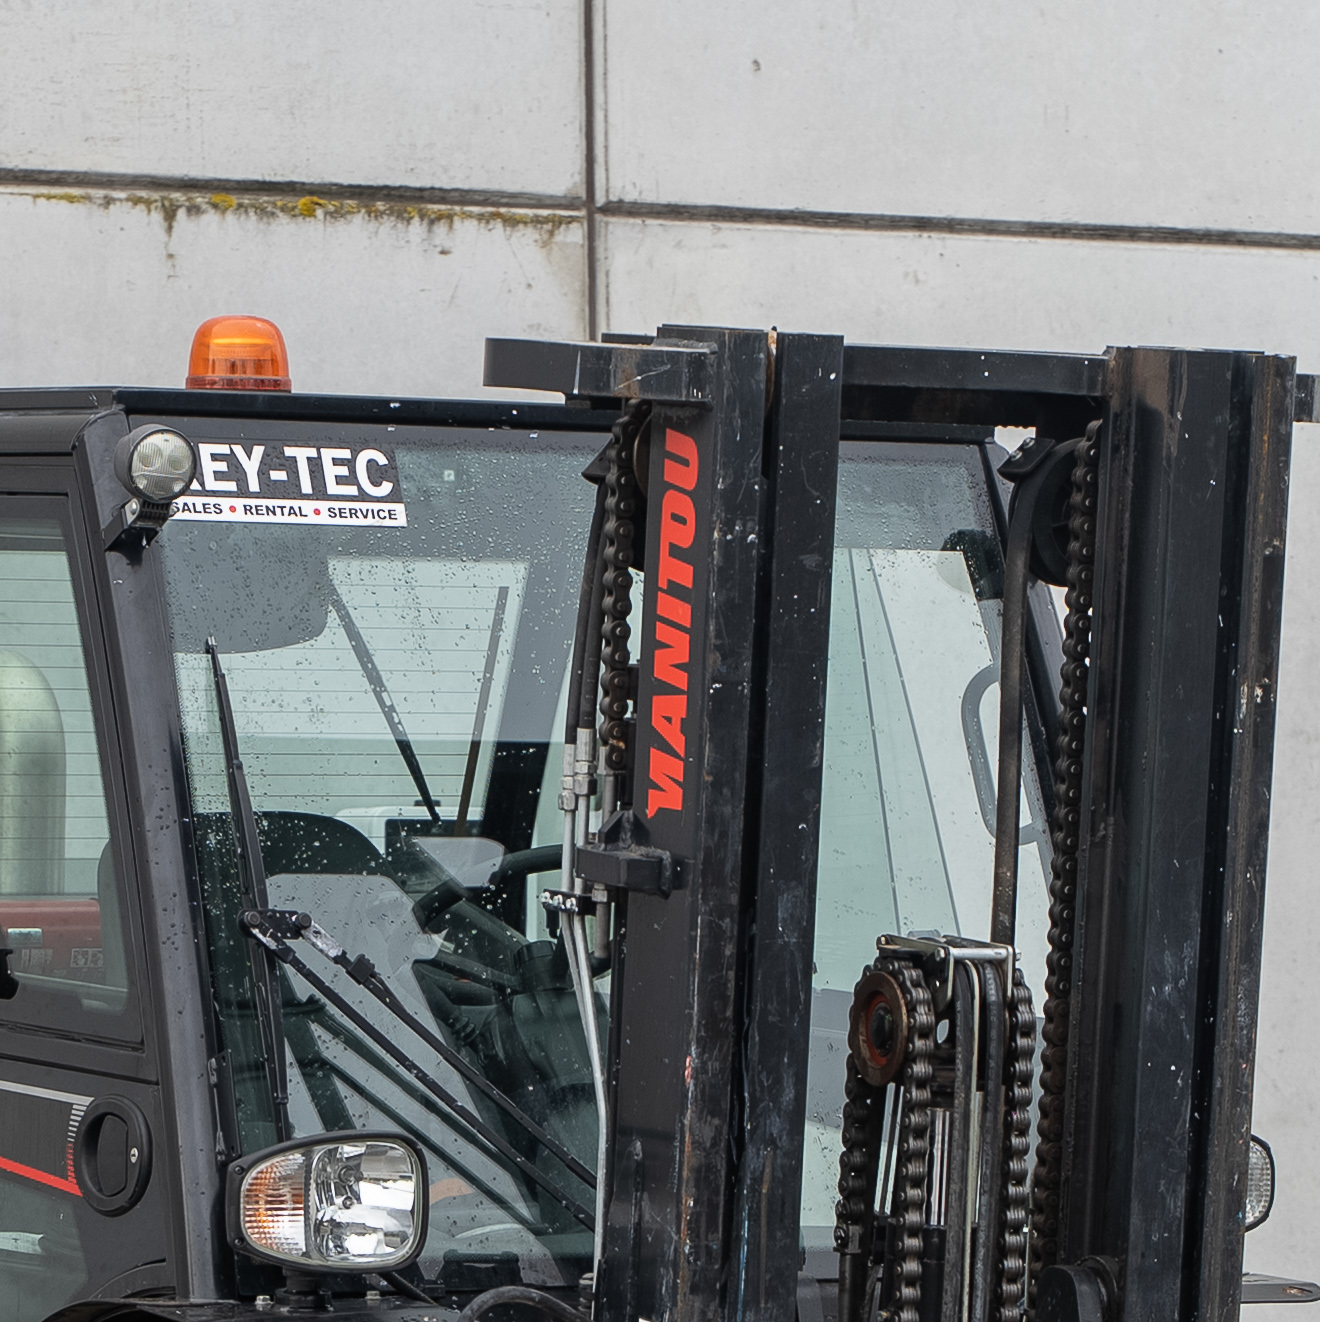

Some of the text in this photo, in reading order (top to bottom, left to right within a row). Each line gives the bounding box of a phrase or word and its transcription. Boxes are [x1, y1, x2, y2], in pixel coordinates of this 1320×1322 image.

[191, 443, 394, 498] EY-TEC
[243, 504, 308, 517] RENTAL
[329, 507, 398, 520] SERVICE
[647, 427, 700, 820] MANITOU
